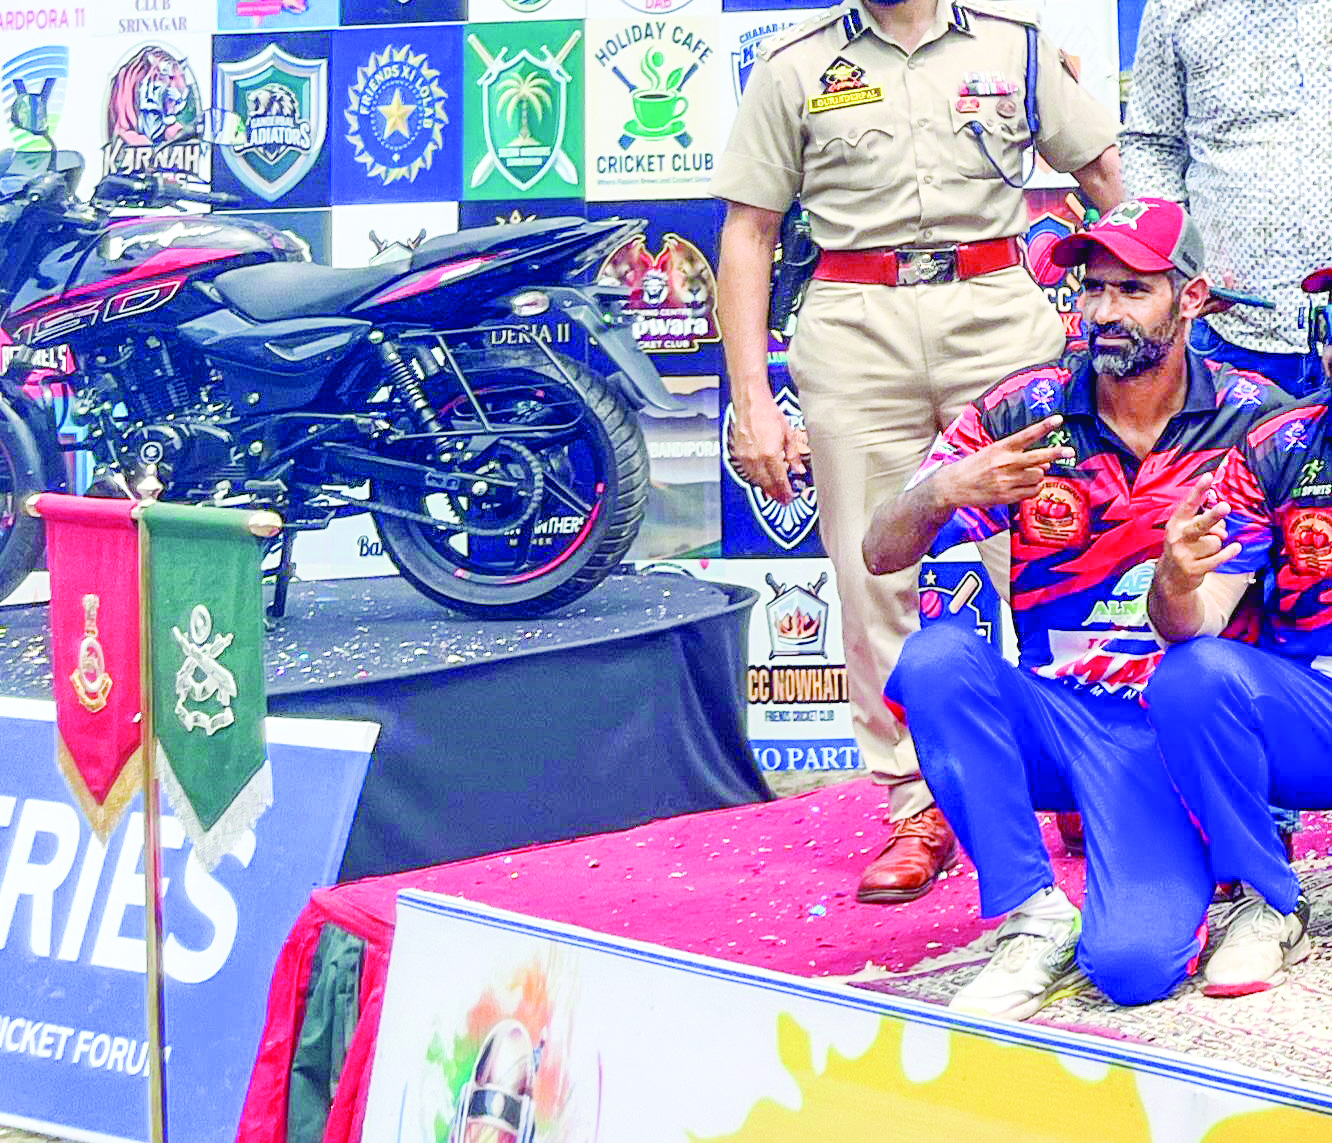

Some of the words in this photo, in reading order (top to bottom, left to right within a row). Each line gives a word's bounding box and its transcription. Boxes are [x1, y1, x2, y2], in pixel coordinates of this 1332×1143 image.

[75, 8, 85, 28] 11
[118, 15, 188, 33] SRINAGAR
[595, 21, 667, 67] HOLIDAY
[672, 25, 714, 64] CAFE
[360, 64, 399, 115] FRIENDS
[400, 67, 415, 82] XI
[415, 77, 434, 129] LOLAB
[815, 89, 878, 109] GURINDERPAL
[234, 120, 312, 154] ADIATORS
[597, 154, 666, 174] CRICKET
[673, 152, 714, 171] CLUB
[632, 315, 709, 340] pwara
[649, 441, 719, 458] BANDIPORA
[746, 666, 770, 703] CC
[765, 710, 791, 722] FRIENDS
[793, 710, 817, 722] CRICKET
[820, 709, 835, 721] CLUB
[0, 1017, 76, 1060] ICKET
[76, 1033, 172, 1078] FORU
